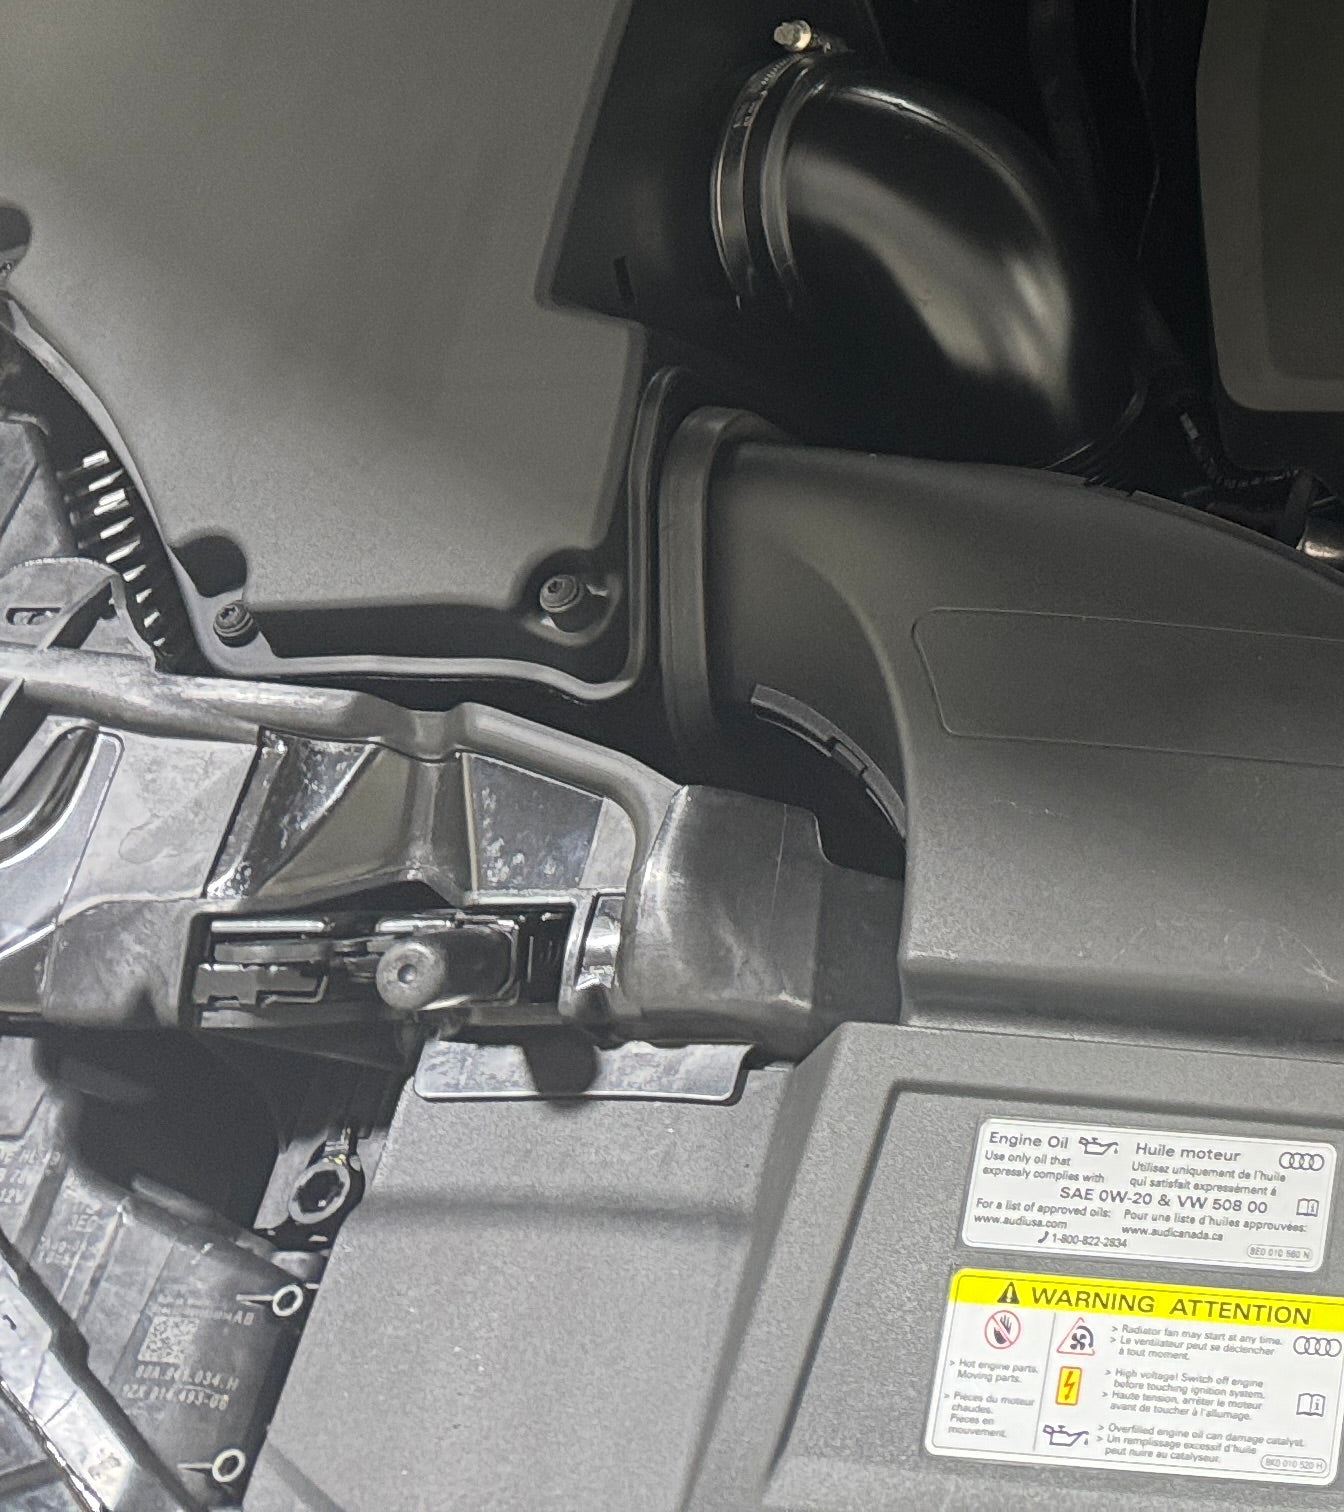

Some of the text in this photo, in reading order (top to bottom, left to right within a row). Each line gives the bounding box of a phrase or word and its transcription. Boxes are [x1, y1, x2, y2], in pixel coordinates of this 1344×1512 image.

[988, 1131, 1068, 1148] Engine Oil
[984, 1149, 1071, 1166] Use only oil that
[1135, 1142, 1241, 1161] Huile moteur
[982, 1166, 1104, 1183] expressly complies with
[1131, 1160, 1169, 1173] Utilisez
[1171, 1165, 1235, 1179] uniquement
[1237, 1169, 1251, 1179] de
[1129, 1175, 1147, 1187] qui
[1149, 1178, 1191, 1190] satisfait
[975, 1197, 1111, 1218] For a list of approved oils:
[1059, 1186, 1267, 1213] SAE 0W-20 & VW 508 00
[973, 1214, 1067, 1229] www.audiusa.com
[1123, 1208, 1148, 1220] Pour
[1151, 1213, 1171, 1222] une
[1173, 1212, 1195, 1224] liste
[1121, 1226, 1223, 1241] www.audicanada.ca
[1031, 1286, 1311, 1325] WARNING ATTENTION
[1121, 1323, 1282, 1345] Radiator fan may start at any time.
[1119, 1335, 1131, 1344] Le
[1133, 1338, 1184, 1348] ventilateur
[1185, 1342, 1207, 1350] peut
[1126, 1347, 1145, 1357] tout
[1147, 1350, 1190, 1360] moment.
[958, 1358, 1038, 1373] Hot engine parts.
[956, 1368, 1022, 1383] Moving parts.
[1114, 1367, 1137, 1379] High
[1180, 1372, 1213, 1383] Switch
[1215, 1375, 1229, 1385] off
[1230, 1378, 1263, 1388] engine
[1113, 1378, 1265, 1399] before touching ignition system.
[985, 1394, 998, 1403] du
[1000, 1396, 1035, 1406] moteur
[1111, 1389, 1140, 1400] Haute
[1216, 1398, 1225, 1407] le
[1227, 1400, 1262, 1409] moteur
[951, 1403, 992, 1414] chaudes.
[1109, 1402, 1137, 1411] avant
[1138, 1403, 1150, 1412] de
[1153, 1405, 1189, 1415] toucher
[981, 1417, 994, 1425] en
[947, 1426, 1007, 1438] mouvement.
[1107, 1422, 1304, 1447] Overfilled engine oil can damage catalyst.
[1106, 1433, 1120, 1443] Un
[1123, 1437, 1181, 1449] remplissage
[1183, 1442, 1222, 1451] excessif
[1104, 1447, 1126, 1455] peut
[1128, 1448, 1153, 1457] nuire
[1169, 1451, 1219, 1462] catalyseur.
